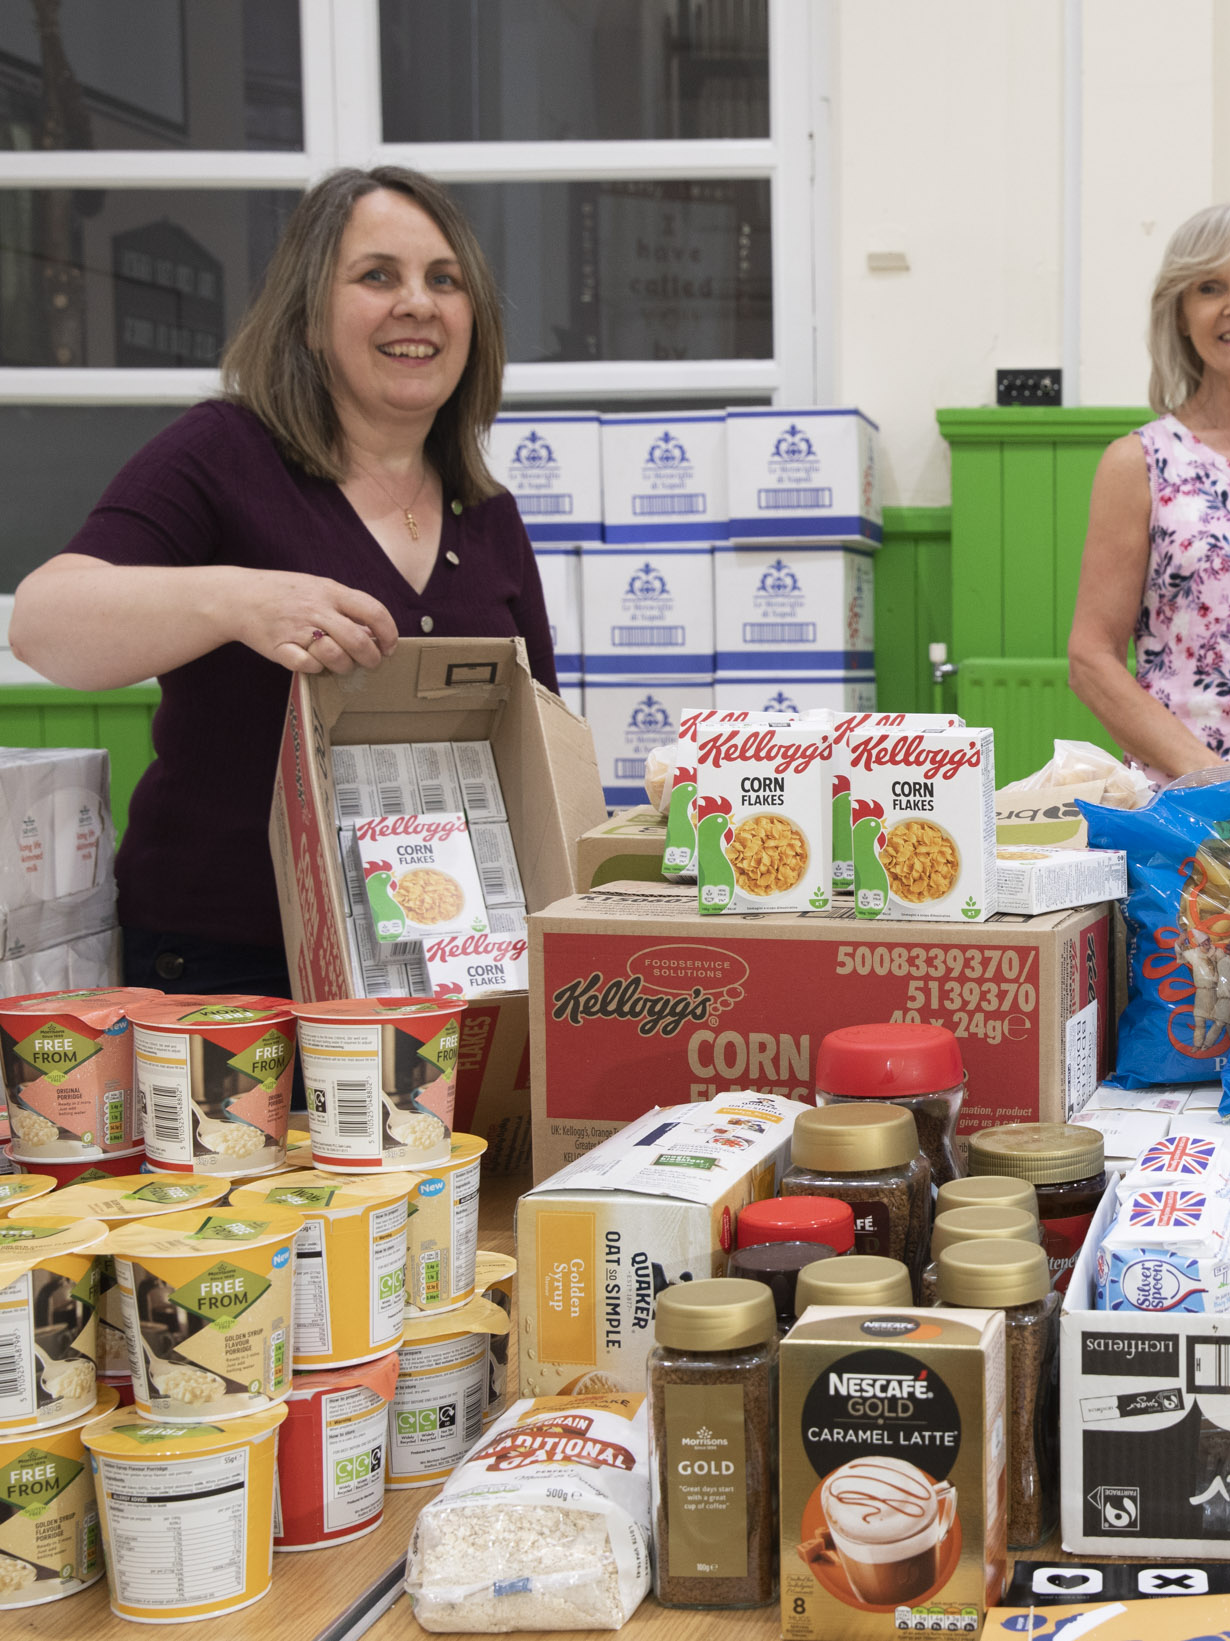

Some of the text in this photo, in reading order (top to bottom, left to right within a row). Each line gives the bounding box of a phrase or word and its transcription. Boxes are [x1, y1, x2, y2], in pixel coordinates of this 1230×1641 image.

[698, 730, 832, 774] Kellogg's
[851, 735, 980, 780] Kellogg's
[741, 777, 784, 793] CORN
[892, 781, 934, 798] CORN
[742, 794, 784, 806] FLAKES
[893, 799, 934, 811] FLAKES
[356, 814, 467, 842] Kellogg's
[396, 844, 434, 856] CORN
[399, 855, 435, 865] FLAKES
[426, 934, 528, 963] Kellogg
[467, 964, 505, 977] CORN
[645, 959, 731, 969] FOODSERVICE
[836, 946, 1035, 983] 5008339370/
[470, 975, 506, 987] FLAKES
[653, 969, 722, 978] SOLUTIONS
[906, 980, 1036, 1013] 5139370
[553, 972, 712, 1037] Kellogg's
[34, 1039, 73, 1051] FREE
[440, 1034, 458, 1049] FREE
[458, 1016, 491, 1070] FLAKES
[33, 1051, 77, 1064] FROM
[256, 1044, 284, 1059] FREE
[688, 1029, 810, 1080] CORN
[252, 1056, 285, 1073] FROM
[996, 1106, 1032, 1117] product
[960, 1118, 992, 1128] give us
[551, 1125, 611, 1137] UK: Kellogg's, Orange
[575, 1140, 597, 1150] Greater
[420, 1181, 444, 1194] New
[273, 1249, 291, 1266] New
[200, 1278, 244, 1297] FREE
[549, 1262, 568, 1311] Syrup
[570, 1258, 585, 1318] Golden
[605, 1230, 621, 1349] OAT SO SIMPLE
[631, 1251, 651, 1330] QUAKER
[1137, 1263, 1151, 1308] Silver
[197, 1292, 248, 1311] FROM
[224, 1328, 264, 1343] GOLDEN SYRUP
[1212, 1324, 1219, 1334] 4
[224, 1339, 250, 1349] FLAVOUR
[225, 1345, 252, 1355] PORRIDGE
[829, 1370, 928, 1398] NESCAFÉ
[848, 1399, 913, 1417] GOLD
[682, 1437, 728, 1446] Morrisons
[808, 1428, 954, 1446] CARAMEL LATTE
[479, 1434, 627, 1470] RADITIONAL
[10, 1463, 56, 1484] FREE
[678, 1461, 735, 1475] GOLD
[7, 1477, 60, 1498] FROM
[546, 1488, 568, 1499] 500g
[679, 1485, 700, 1493] "Great
[702, 1485, 717, 1494] days
[709, 1494, 726, 1502] great
[684, 1503, 697, 1511] cup
[35, 1512, 76, 1530] GOLDEN SYRUP
[35, 1524, 61, 1535] FLAVOUR
[36, 1530, 64, 1542] PORRIDGE
[792, 1597, 806, 1615] 8
